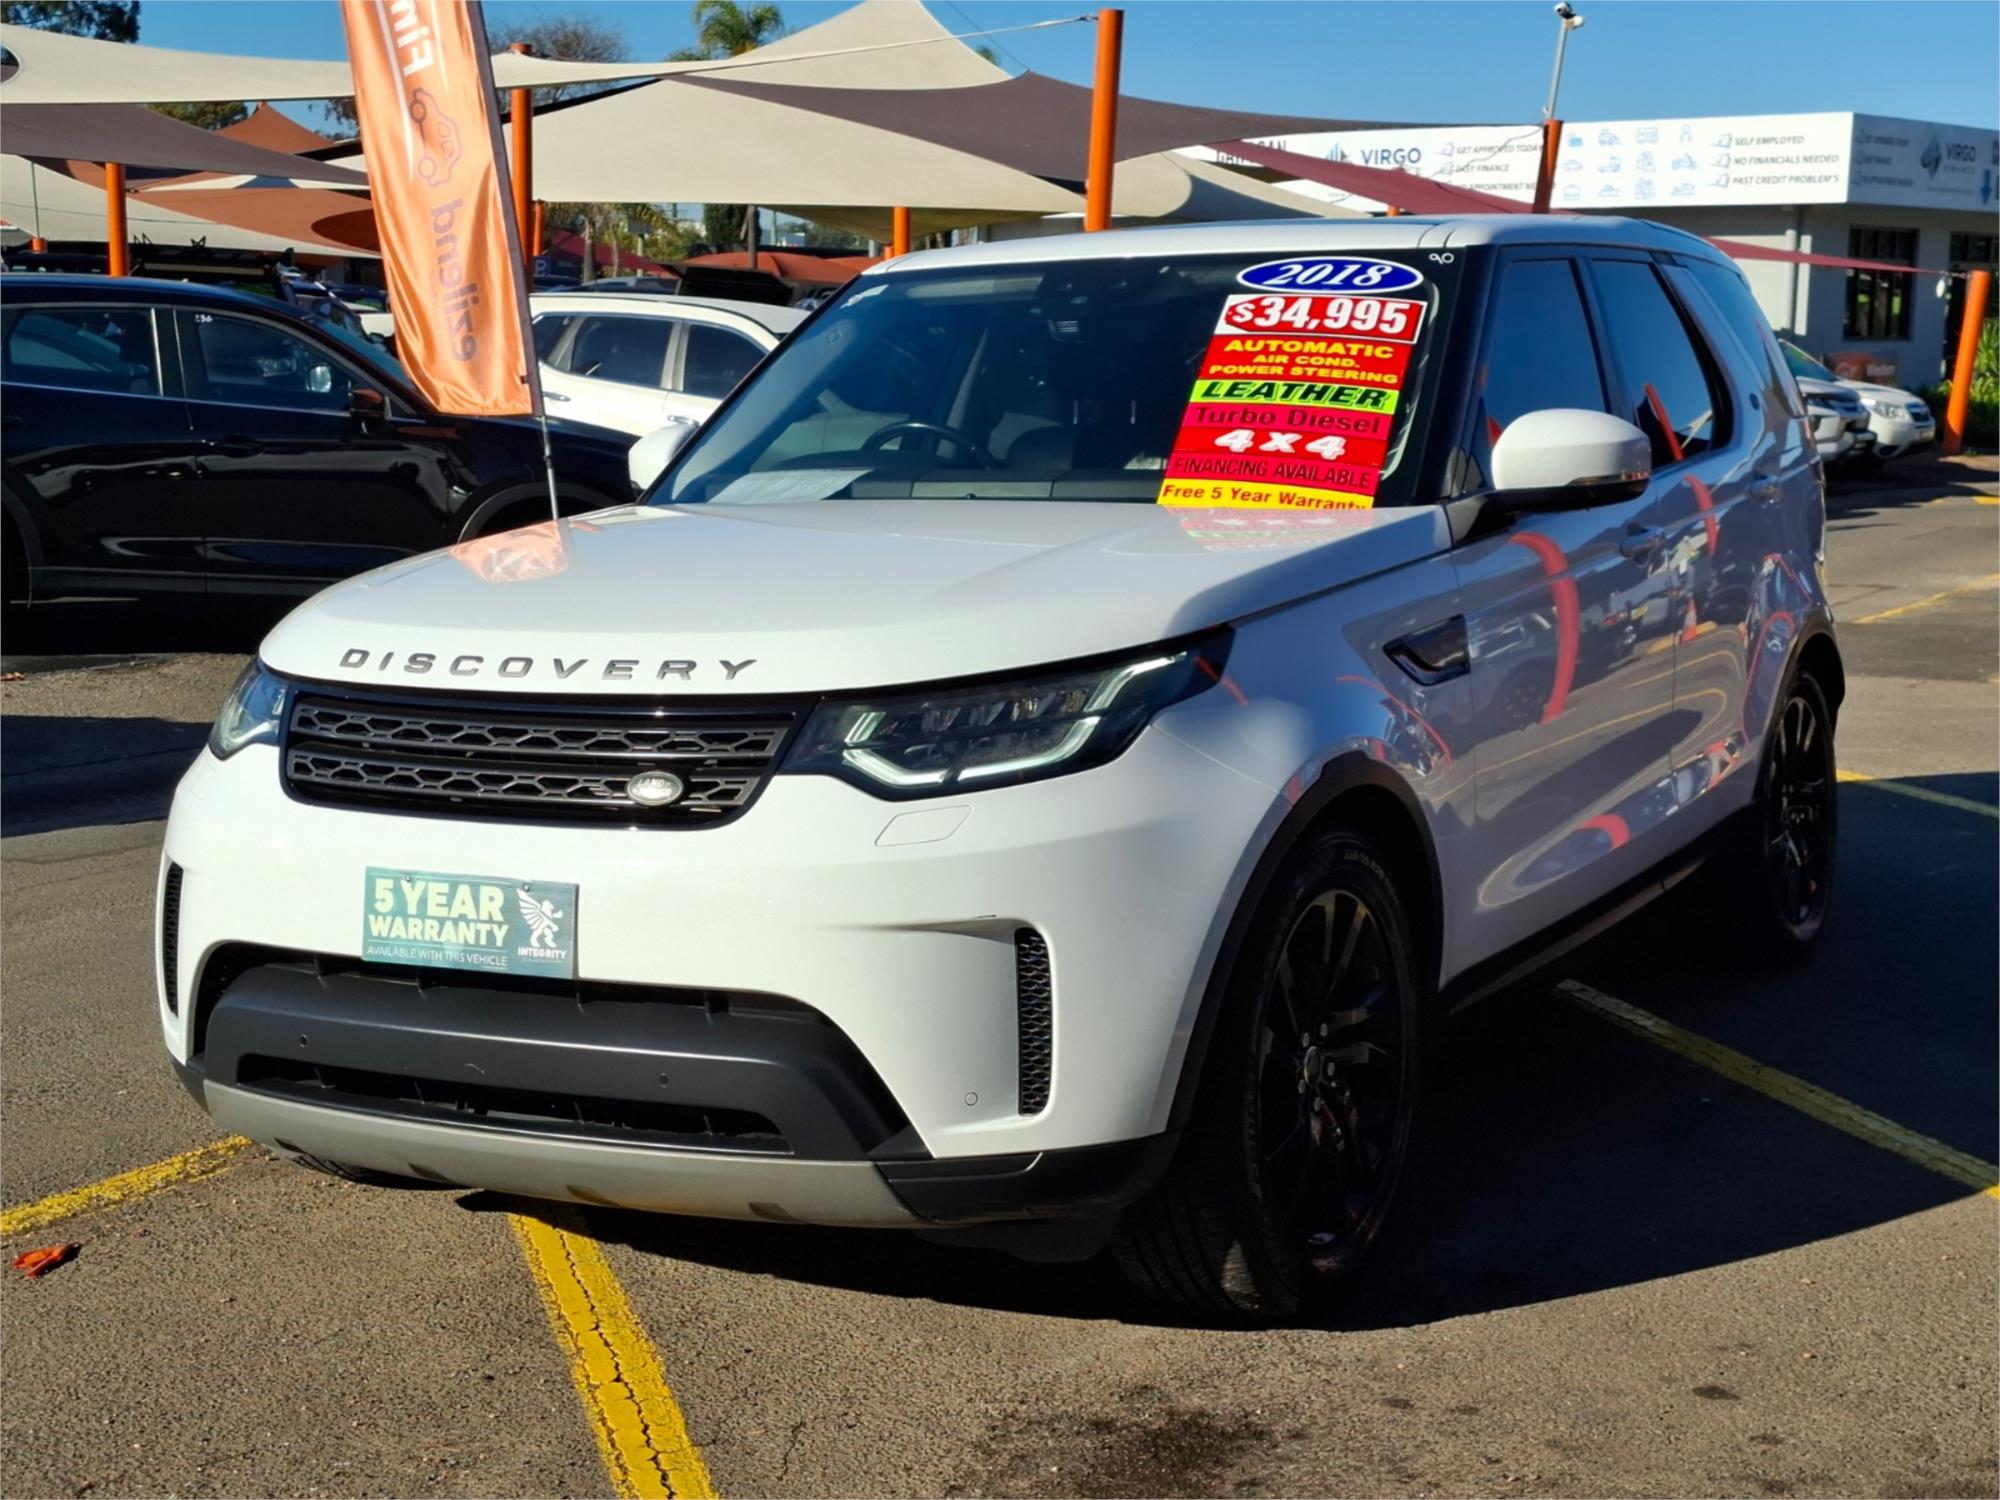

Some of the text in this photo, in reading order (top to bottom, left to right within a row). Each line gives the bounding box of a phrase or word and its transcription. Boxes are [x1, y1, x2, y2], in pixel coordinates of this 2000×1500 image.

[1457, 146, 1471, 154] GET
[1473, 145, 1515, 154] APPROVED
[1735, 135, 1804, 146] SELF EMPLOYED
[1362, 147, 1421, 165] VIRGO
[1734, 154, 1839, 165] NO FINANCIALS NEEDED
[1946, 143, 1977, 162] VIRGO
[1477, 163, 1509, 172] FINANCE
[1733, 175, 1754, 185] PAST
[1755, 175, 1787, 185] CREDIT
[1262, 263, 1393, 286] 2018
[1232, 296, 1411, 334] $34,995
[1224, 340, 1394, 358] AUTOMATIC
[1253, 354, 1360, 368] AIR COND.
[1209, 365, 1398, 384] POWER STEERING
[1200, 381, 1390, 410] LEATHER
[1197, 407, 1380, 434] Turbo Diesel
[1172, 456, 1370, 489] FINANCING AVAILABLE
[1162, 484, 1202, 499] Free
[1211, 487, 1222, 499] 5
[1230, 487, 1271, 503] Year
[339, 648, 758, 681] DISCOVERY
[374, 878, 505, 922] 5 YEAR
[368, 914, 509, 947] WARRANTY
[367, 947, 416, 959] AVAILABLE
[417, 948, 441, 960] WITH
[444, 950, 464, 963] THIS
[467, 953, 508, 966] VEHICLE
[518, 946, 566, 960] INTEGRITY
